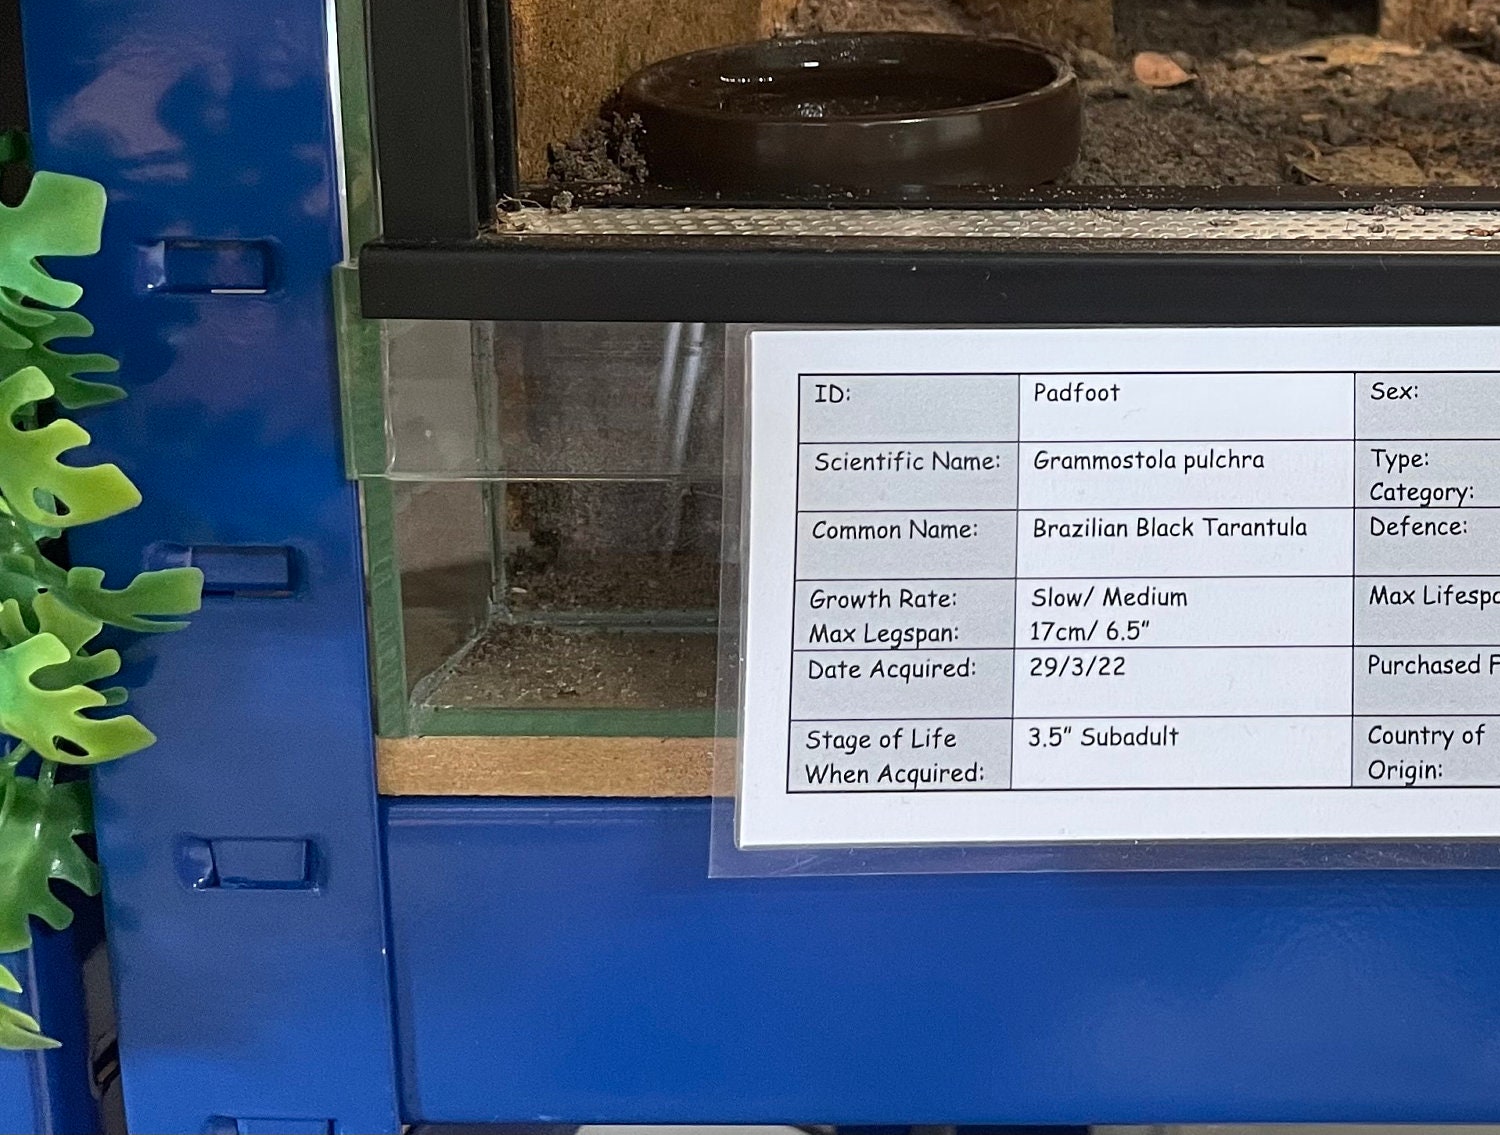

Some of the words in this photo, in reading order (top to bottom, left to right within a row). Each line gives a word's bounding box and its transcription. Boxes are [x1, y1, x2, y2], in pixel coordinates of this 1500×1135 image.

[815, 384, 850, 403] ID:
[1035, 382, 1120, 403] Padfoot
[1371, 382, 1418, 400] Sex:
[815, 451, 923, 472] Scientific
[932, 451, 999, 470] Name:
[1034, 449, 1176, 470] Grammostola
[1185, 448, 1264, 475] pulchra
[1371, 449, 1428, 474] Type:
[1370, 482, 1473, 506] Category:
[812, 521, 901, 540] Common
[910, 519, 977, 539] Name:
[1034, 517, 1127, 538] Brazilian
[1137, 516, 1193, 537] Black
[1202, 516, 1307, 536] Tarantula
[1371, 515, 1467, 537] Defence:
[810, 588, 891, 609] Growth
[900, 589, 956, 608] Rate:
[1032, 586, 1095, 607] Slow/
[1103, 586, 1187, 607] Medium
[1369, 585, 1415, 605] Max
[809, 624, 856, 643] Max
[862, 623, 959, 650] Legspan:
[1031, 620, 1098, 641] 17cm/
[809, 660, 861, 679] Date
[870, 657, 975, 684] Acquired:
[1030, 656, 1125, 677] 29/3/22
[1369, 653, 1480, 675] Purchased
[806, 730, 871, 755] Stage
[880, 727, 903, 750] of
[912, 727, 956, 749] Life
[1081, 725, 1179, 746] Subadult
[1368, 725, 1453, 751] Country
[1461, 723, 1486, 746] of
[805, 763, 868, 784] When
[877, 761, 983, 789] Acquired:
[1369, 760, 1443, 785] Origin:
